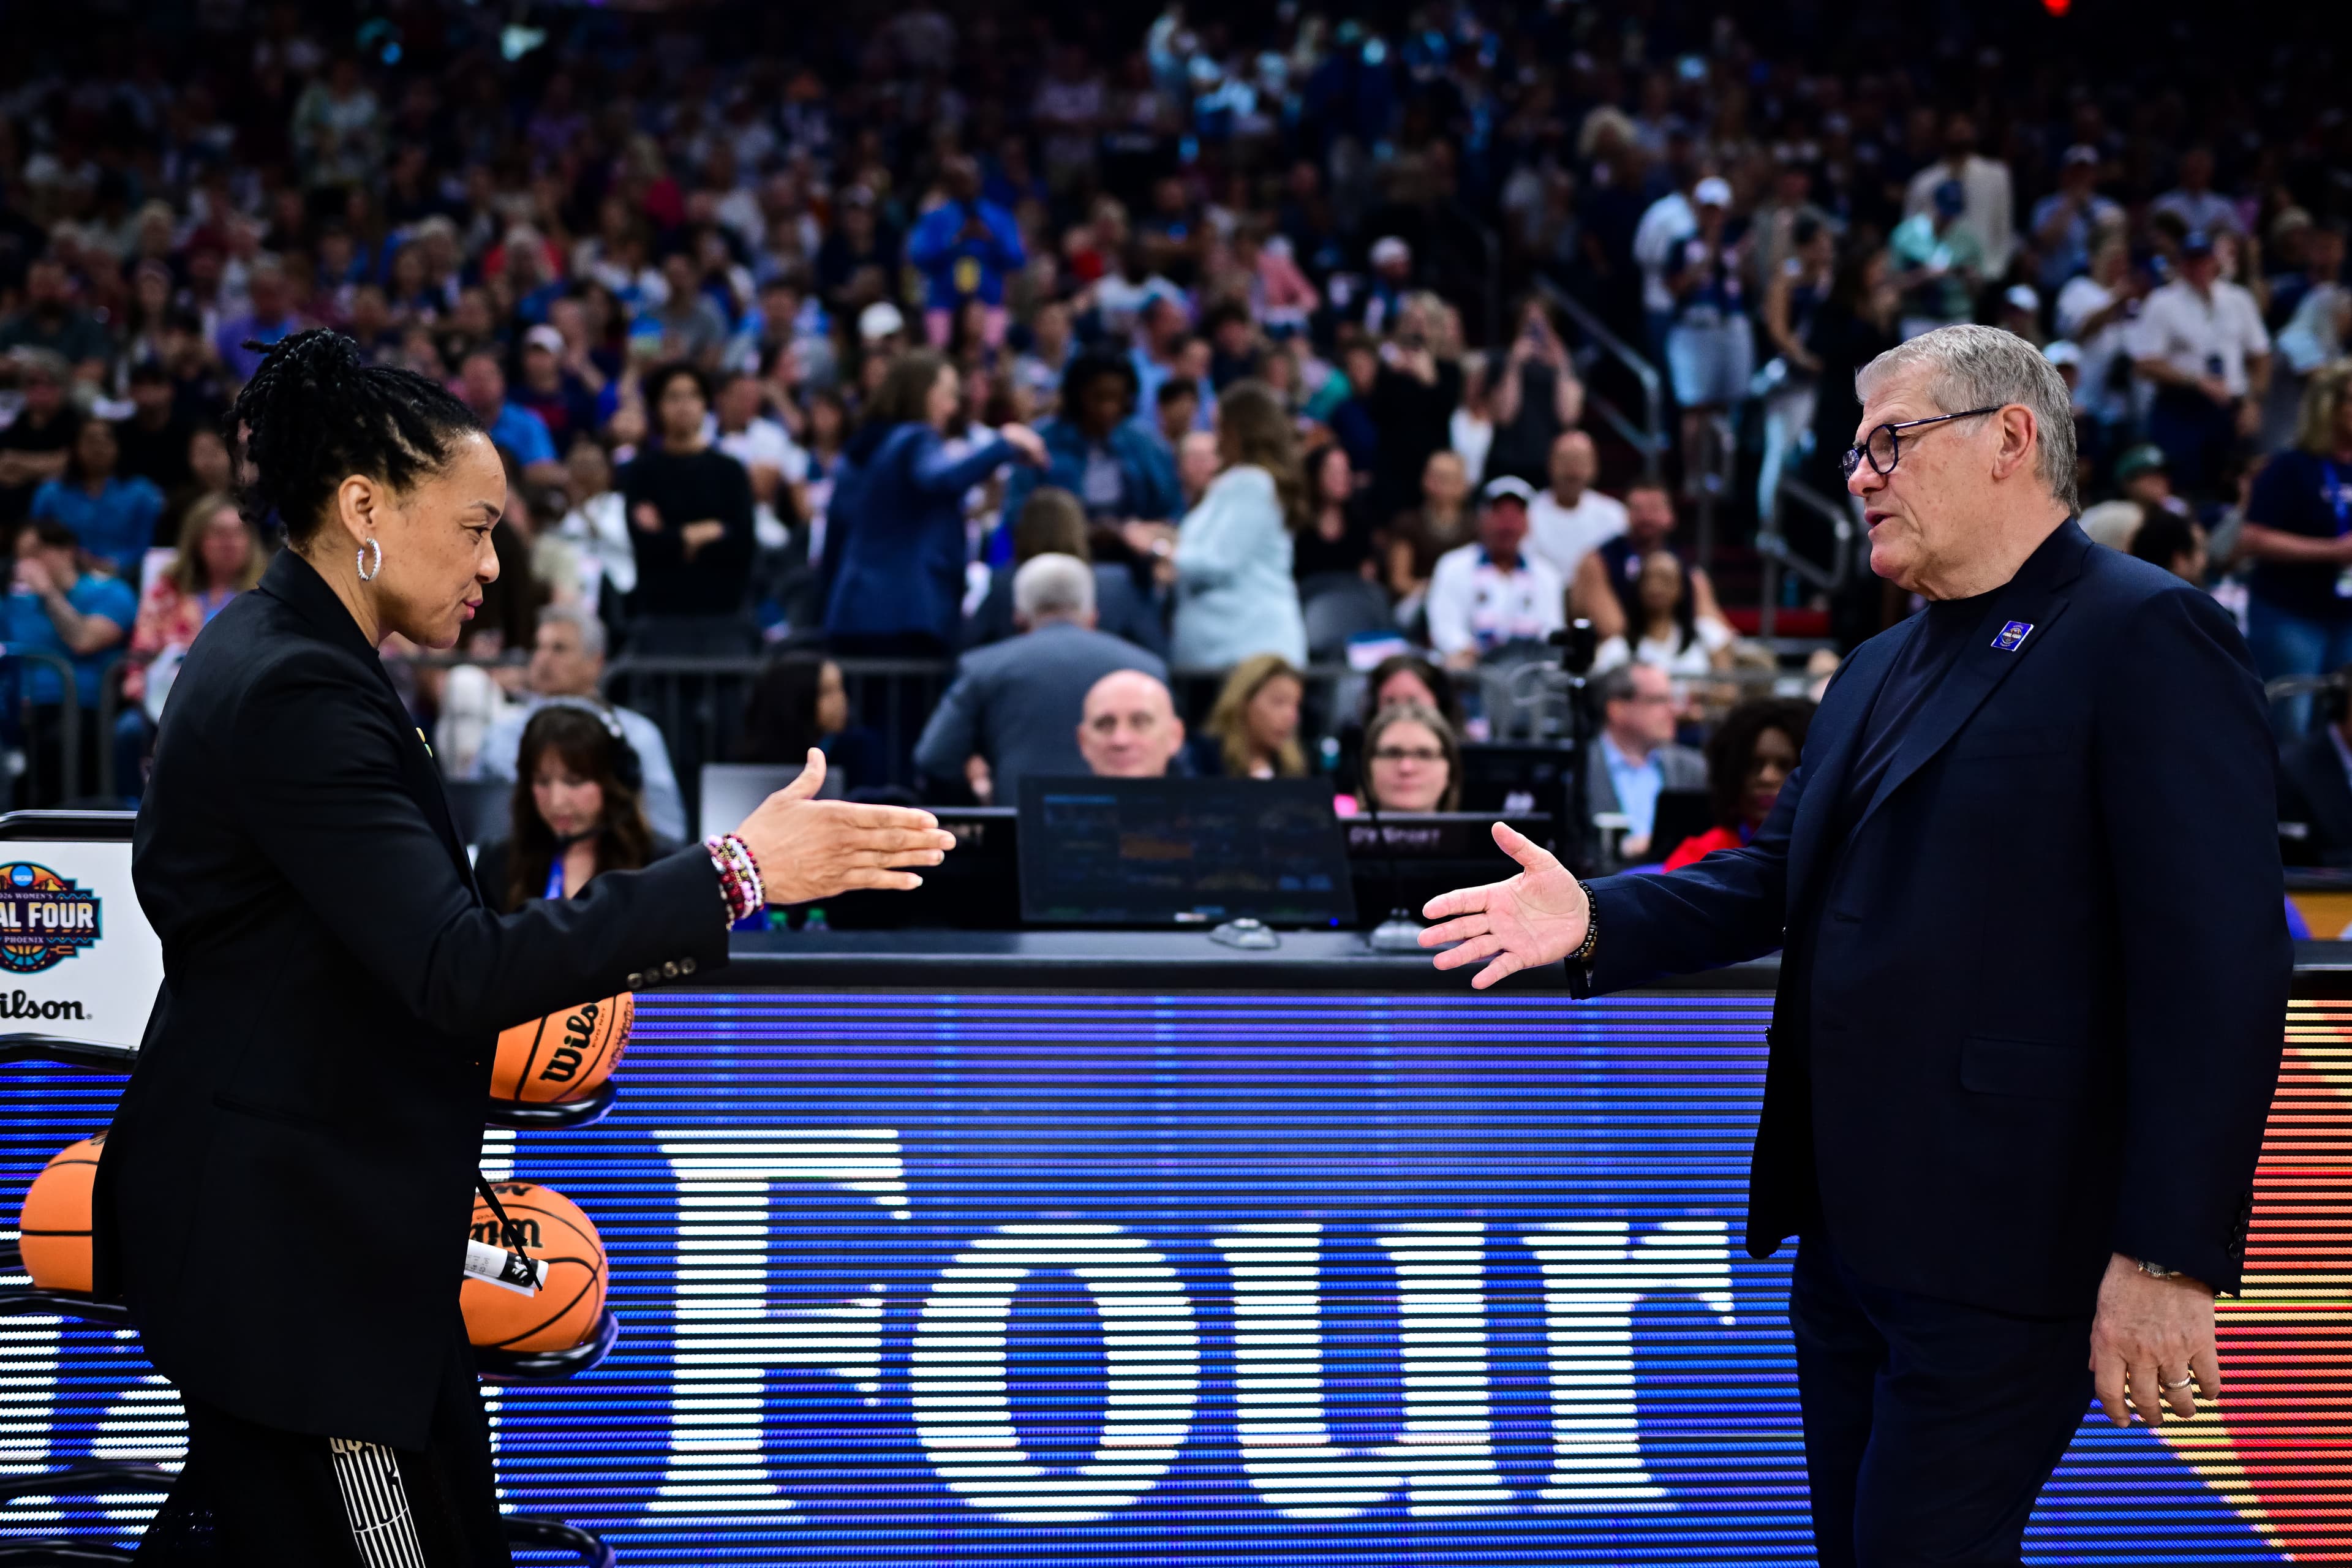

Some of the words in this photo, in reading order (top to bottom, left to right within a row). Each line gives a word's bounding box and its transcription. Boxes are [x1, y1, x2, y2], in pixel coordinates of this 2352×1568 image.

[28, 902, 94, 928] FOUR
[0, 989, 85, 1020] ilson
[647, 1129, 1735, 1522] Four
